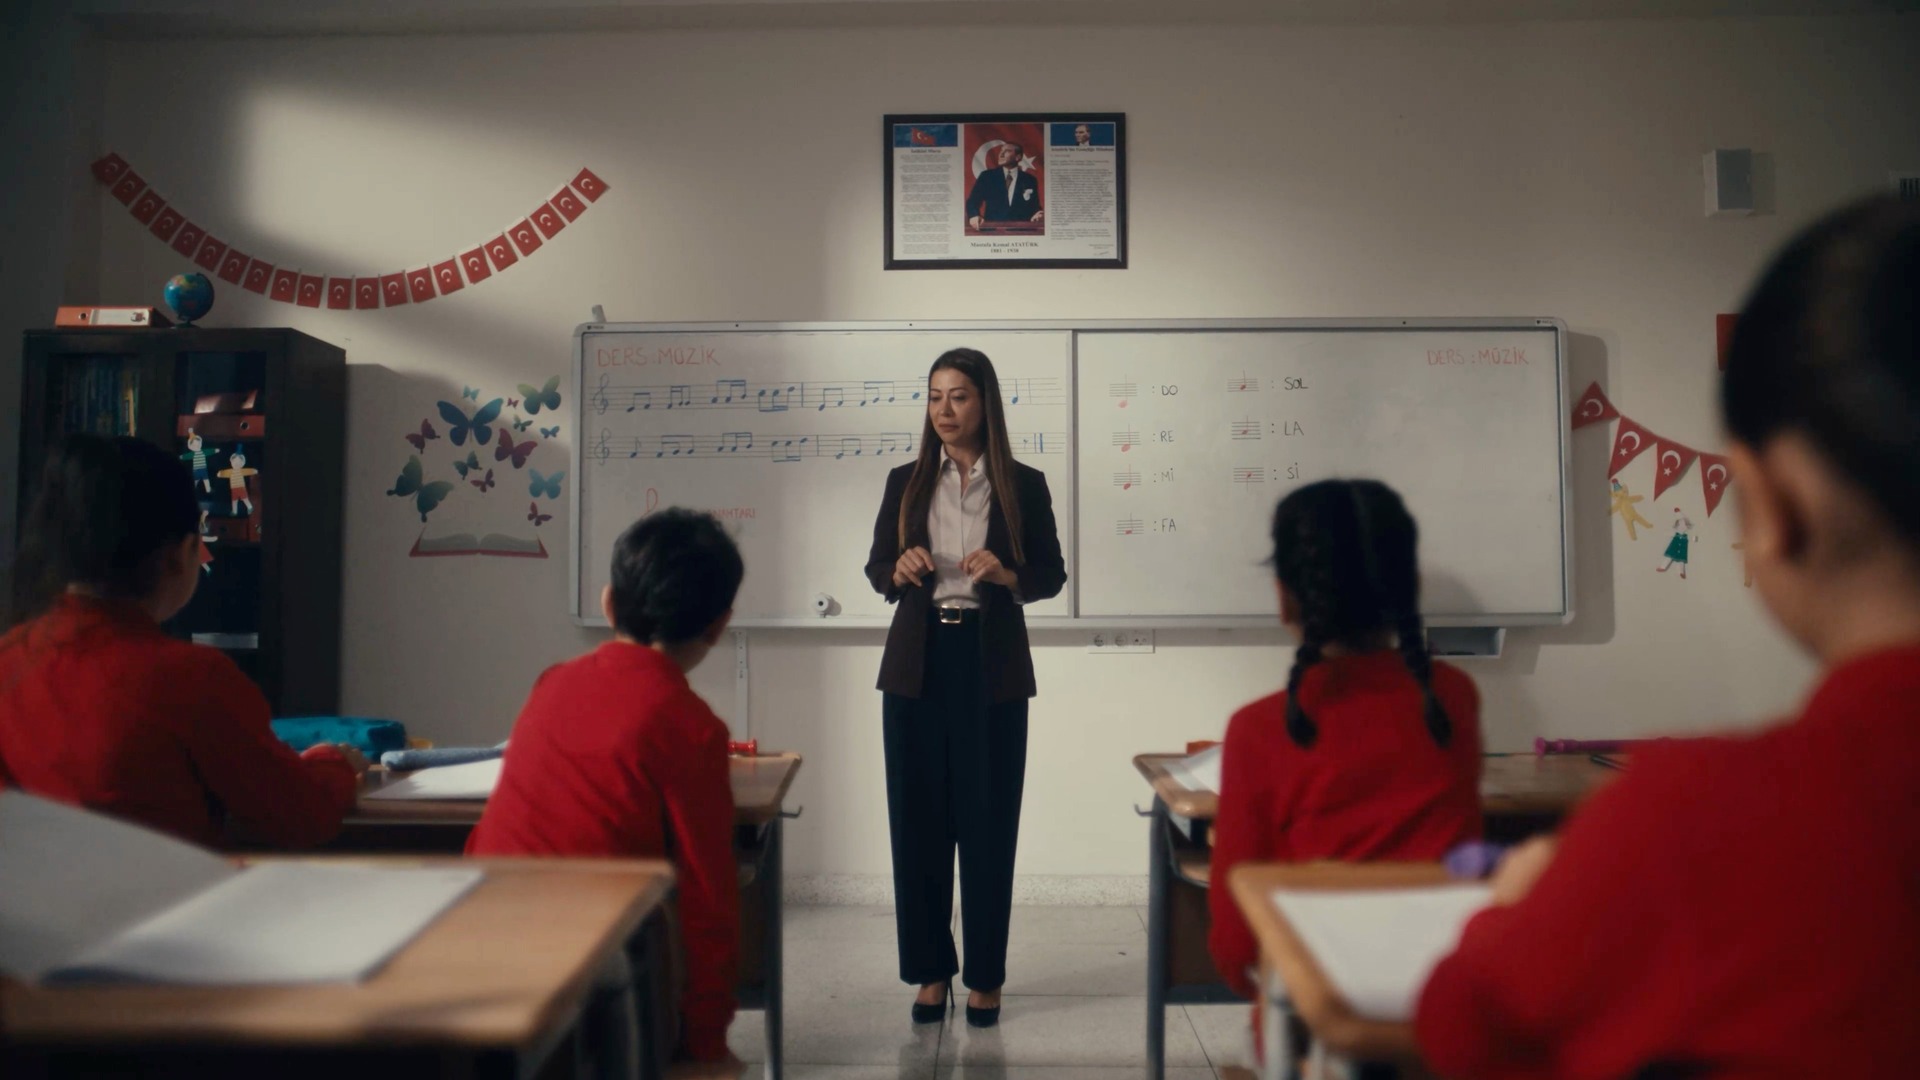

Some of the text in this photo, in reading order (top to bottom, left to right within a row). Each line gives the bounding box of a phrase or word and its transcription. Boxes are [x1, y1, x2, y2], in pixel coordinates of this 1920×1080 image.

[597, 347, 648, 368] DERS
[1426, 348, 1465, 366] DERS
[1161, 384, 1179, 396] DO
[1284, 376, 1309, 391] SOL
[1160, 429, 1175, 443] RE
[1284, 420, 1305, 437] LA
[1161, 467, 1174, 482] Mİ
[1287, 462, 1300, 480] Sİ
[1161, 518, 1177, 533] FA
